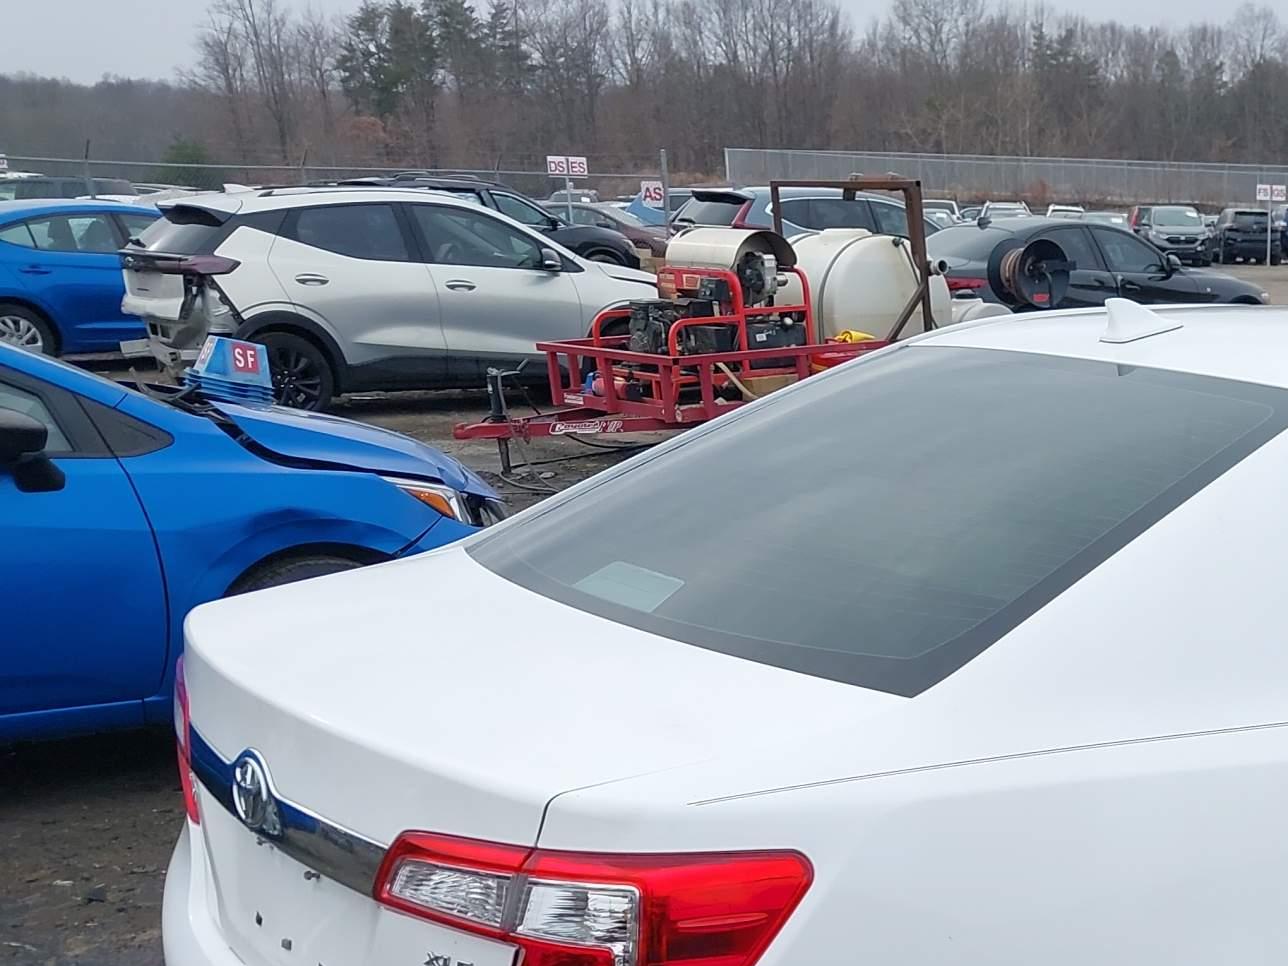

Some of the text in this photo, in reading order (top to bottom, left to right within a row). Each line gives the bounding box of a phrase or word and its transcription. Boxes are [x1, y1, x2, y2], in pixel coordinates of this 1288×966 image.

[548, 160, 566, 173] DS
[570, 161, 586, 173] ES
[643, 187, 664, 201] AS
